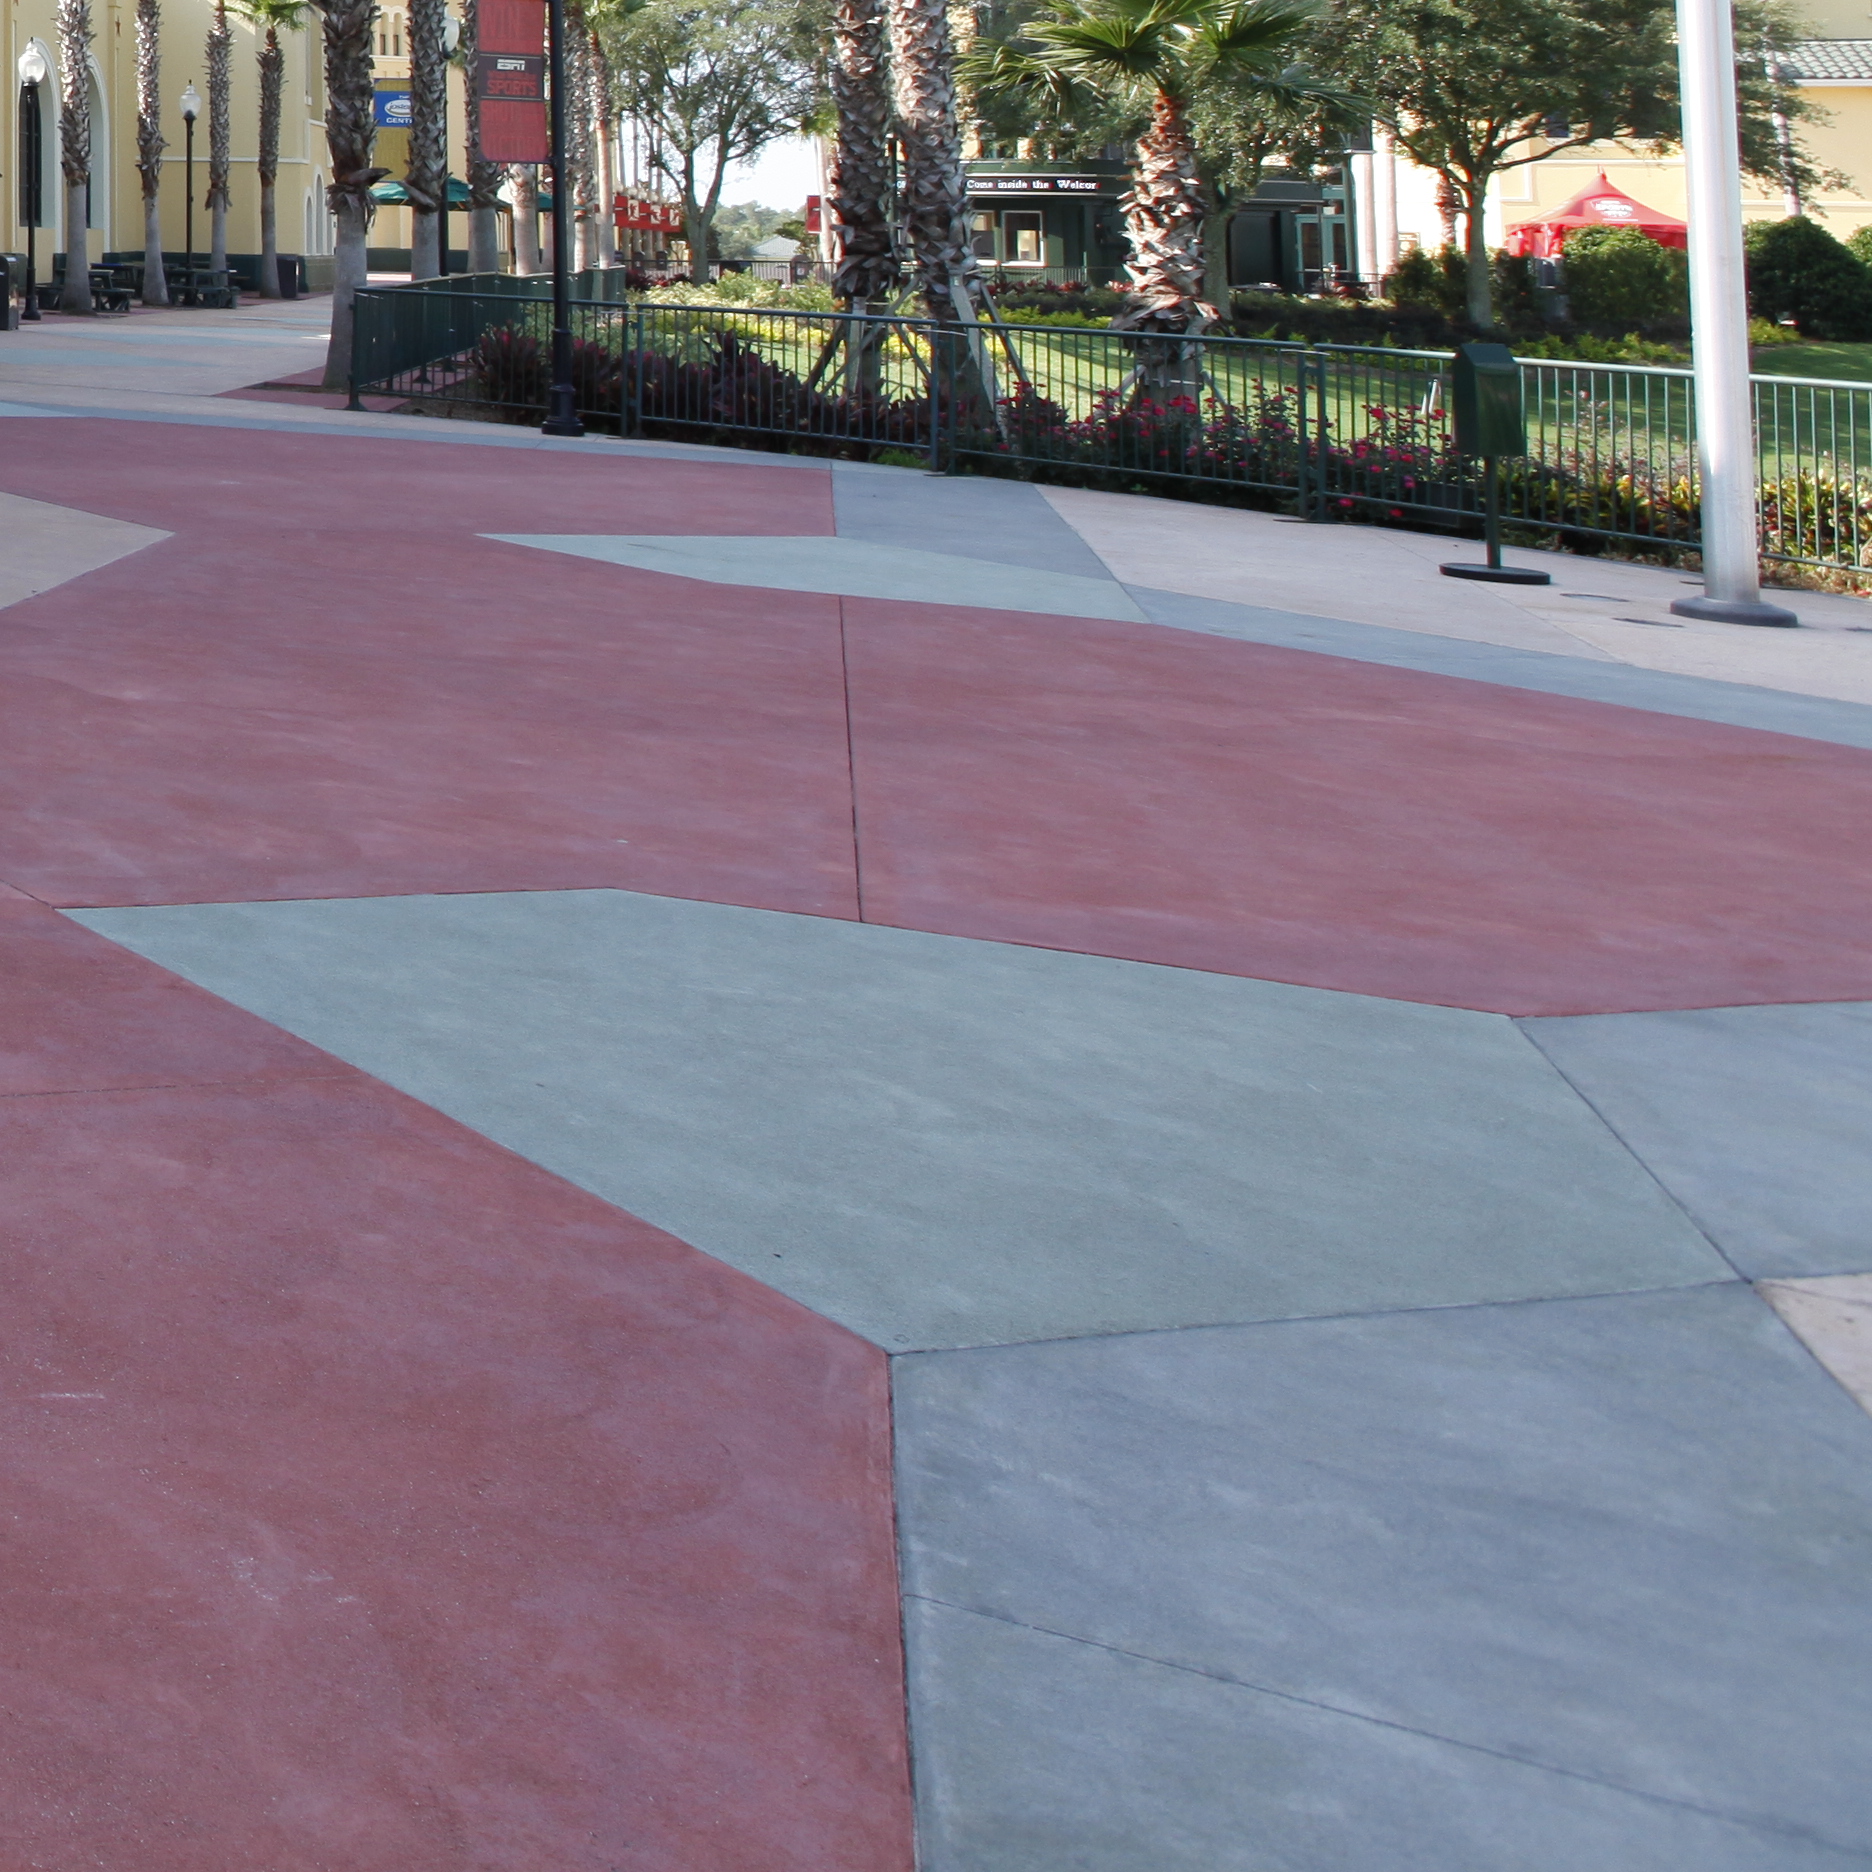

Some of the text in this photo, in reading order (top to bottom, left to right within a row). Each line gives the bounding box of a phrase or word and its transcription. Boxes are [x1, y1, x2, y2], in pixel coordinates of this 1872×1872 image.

[496, 58, 526, 71] ESPN
[486, 78, 538, 97] SPORTS
[1032, 179, 1050, 189] the
